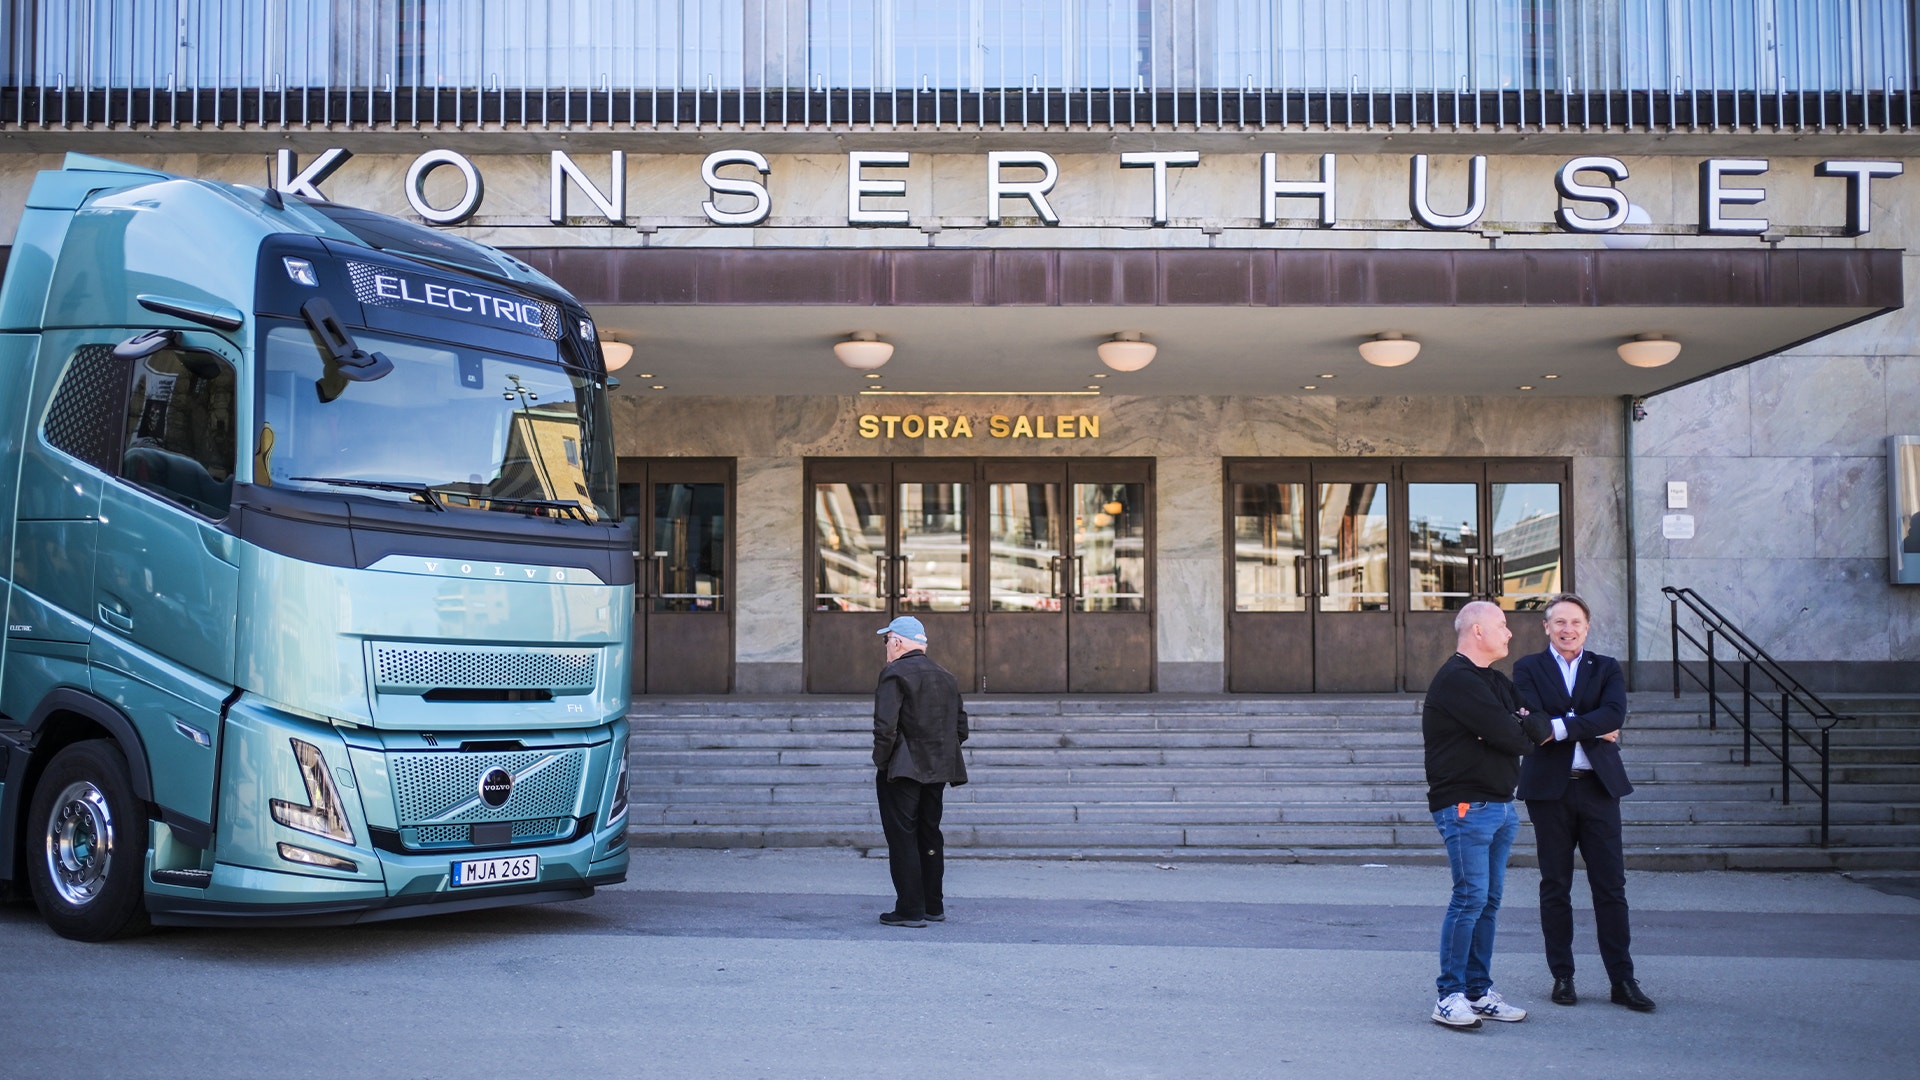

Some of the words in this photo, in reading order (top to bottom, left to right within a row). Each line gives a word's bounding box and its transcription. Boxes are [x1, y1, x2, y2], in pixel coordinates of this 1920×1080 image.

[276, 147, 1904, 238] KONSERTHUSET
[374, 274, 543, 327] ELECTRIC
[859, 414, 973, 438] STORA
[990, 415, 1099, 438] SALEN
[424, 561, 565, 581] VOLVO
[567, 703, 583, 713] FH
[466, 861, 497, 882] MJA
[501, 859, 531, 879] 26S
